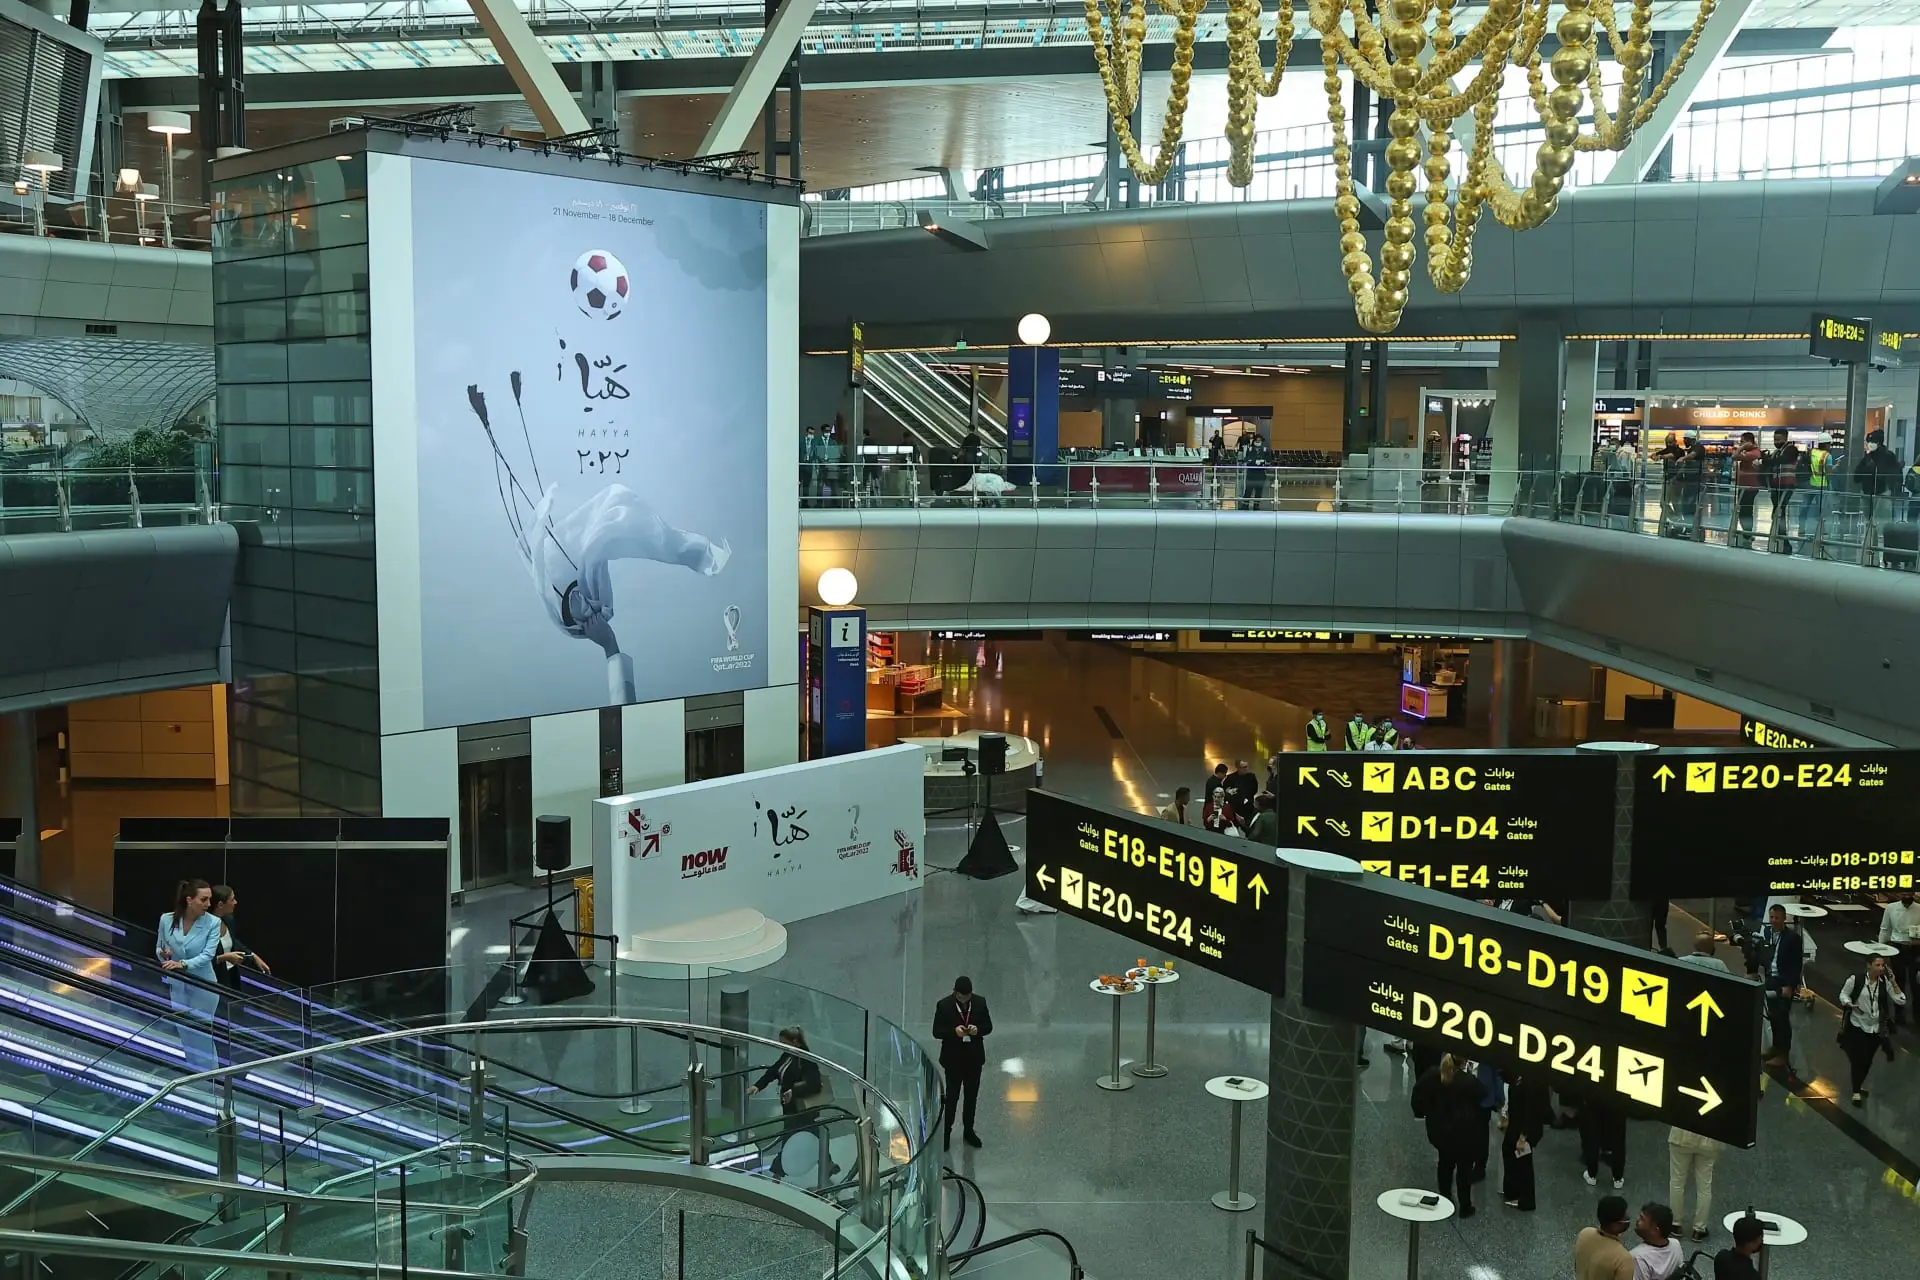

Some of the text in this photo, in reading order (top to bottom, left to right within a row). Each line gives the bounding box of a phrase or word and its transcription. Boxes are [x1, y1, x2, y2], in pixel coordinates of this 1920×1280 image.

[552, 207, 561, 216] 21
[562, 208, 601, 220] November
[608, 213, 617, 222] 18
[618, 214, 655, 226] December
[1833, 322, 1858, 341] E18-E24
[1693, 410, 1767, 418] CHILLED DRINKS
[577, 429, 630, 438] HAYYA
[1766, 729, 1814, 748] E20-E
[1484, 767, 1515, 779] بوابات
[1722, 763, 1852, 790] E20-E24
[1859, 763, 1888, 775] بوابات
[1402, 766, 1476, 791] ABC
[1483, 783, 1511, 791] Gates
[1858, 778, 1884, 787] Gates
[1077, 821, 1100, 839] بوابات
[1400, 815, 1499, 840] D1-D4
[1507, 817, 1538, 829] بوابات
[1506, 832, 1534, 840] Gates
[1079, 839, 1099, 853] Gates
[681, 846, 729, 871] now
[1104, 828, 1204, 887] E18-E19
[1767, 857, 1793, 866] Gates
[1800, 855, 1829, 867] بوابات
[1830, 852, 1898, 867] D18-D19
[1399, 864, 1490, 888] E1-E4
[1498, 866, 1529, 877] بوابات
[1497, 881, 1524, 889] Gates
[1769, 881, 1795, 890] Gates
[1802, 879, 1831, 891] بوابات
[1832, 875, 1897, 890] E18-E19
[1087, 881, 1194, 947] E20-E24
[1383, 914, 1420, 937] بوابات
[1199, 924, 1226, 945] بوابات
[1199, 942, 1223, 959] Gates
[1386, 935, 1419, 954] Gates
[1428, 923, 1609, 1004] D18-D19
[1368, 980, 1404, 1004] بوابات
[1371, 1002, 1403, 1021] Gates
[1412, 991, 1605, 1083] D20-D24
